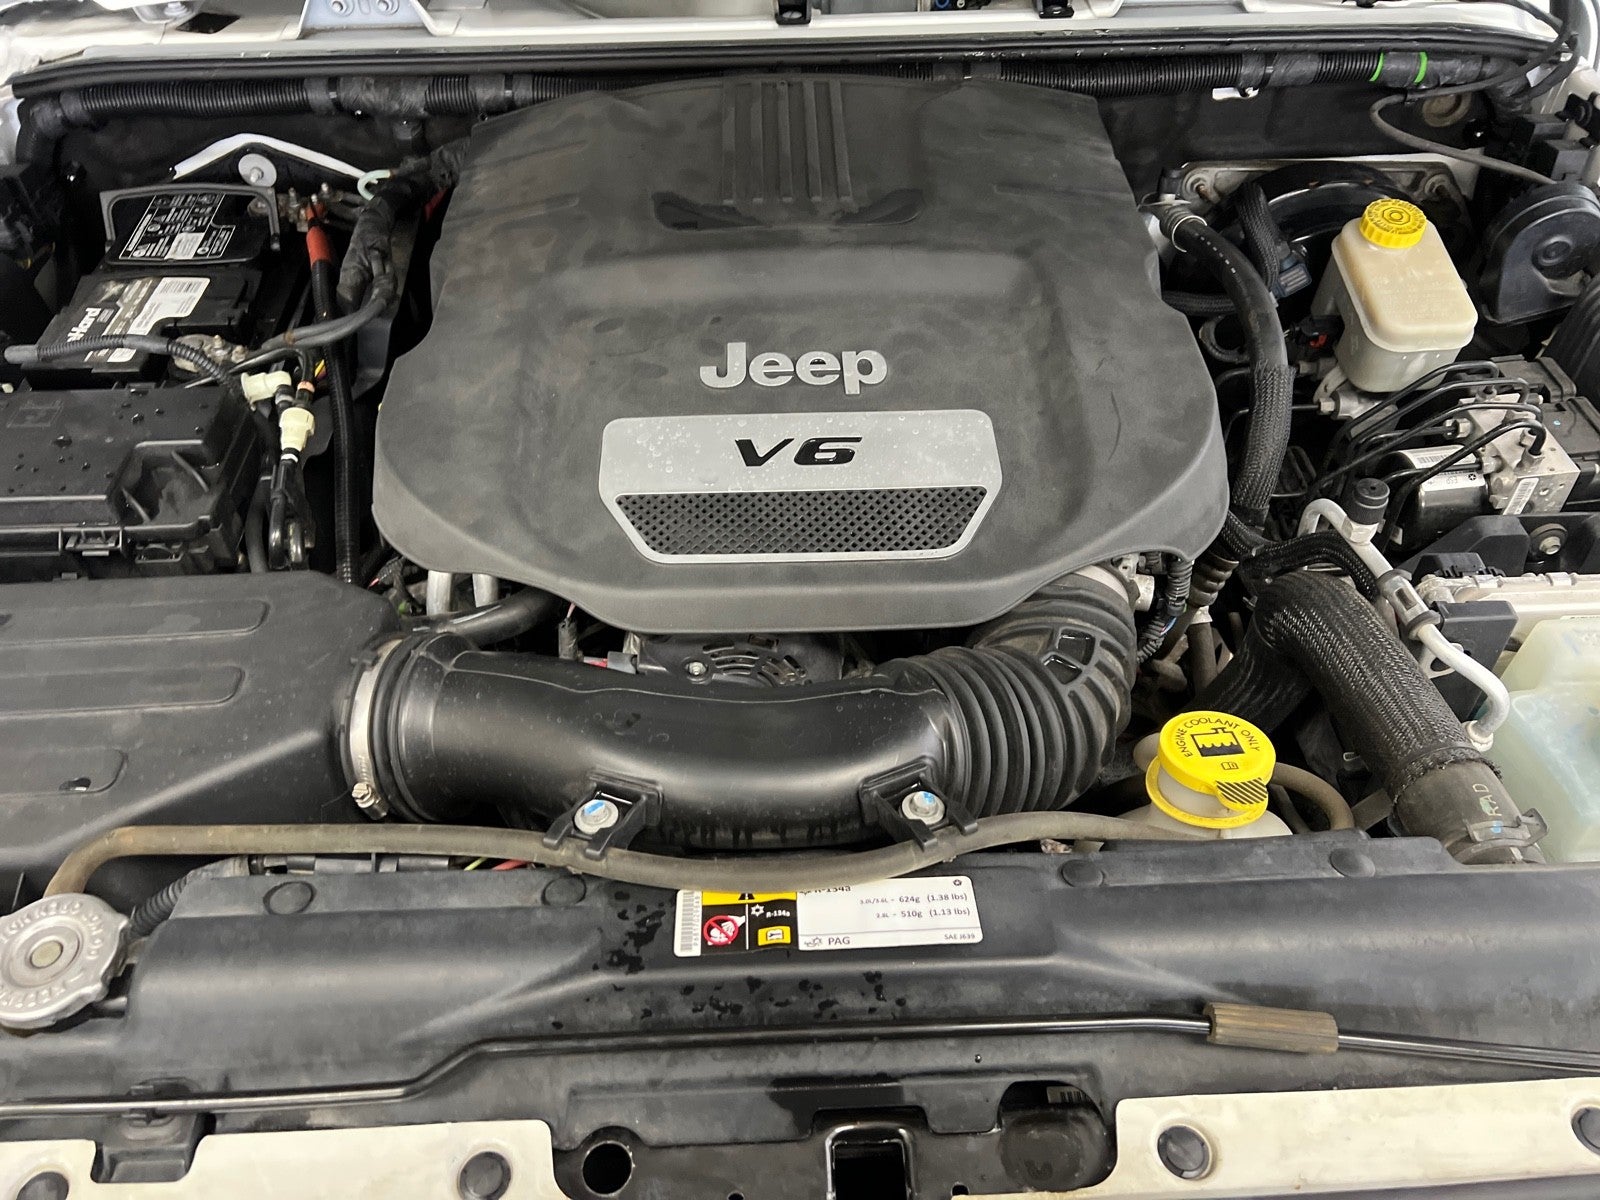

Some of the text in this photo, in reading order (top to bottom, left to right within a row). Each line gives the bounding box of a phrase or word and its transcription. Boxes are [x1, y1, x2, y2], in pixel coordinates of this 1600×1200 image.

[699, 341, 888, 395] Jeep
[735, 436, 863, 467] V6
[1176, 717, 1261, 757] ENGINE COOLANT ONLY
[899, 895, 920, 904] 624g
[927, 892, 949, 903] (1.38
[951, 892, 968, 902] lbs)
[901, 909, 923, 918] 510g
[929, 907, 952, 918] (1.13
[954, 906, 971, 916] lbs)
[828, 936, 851, 946] PAG
